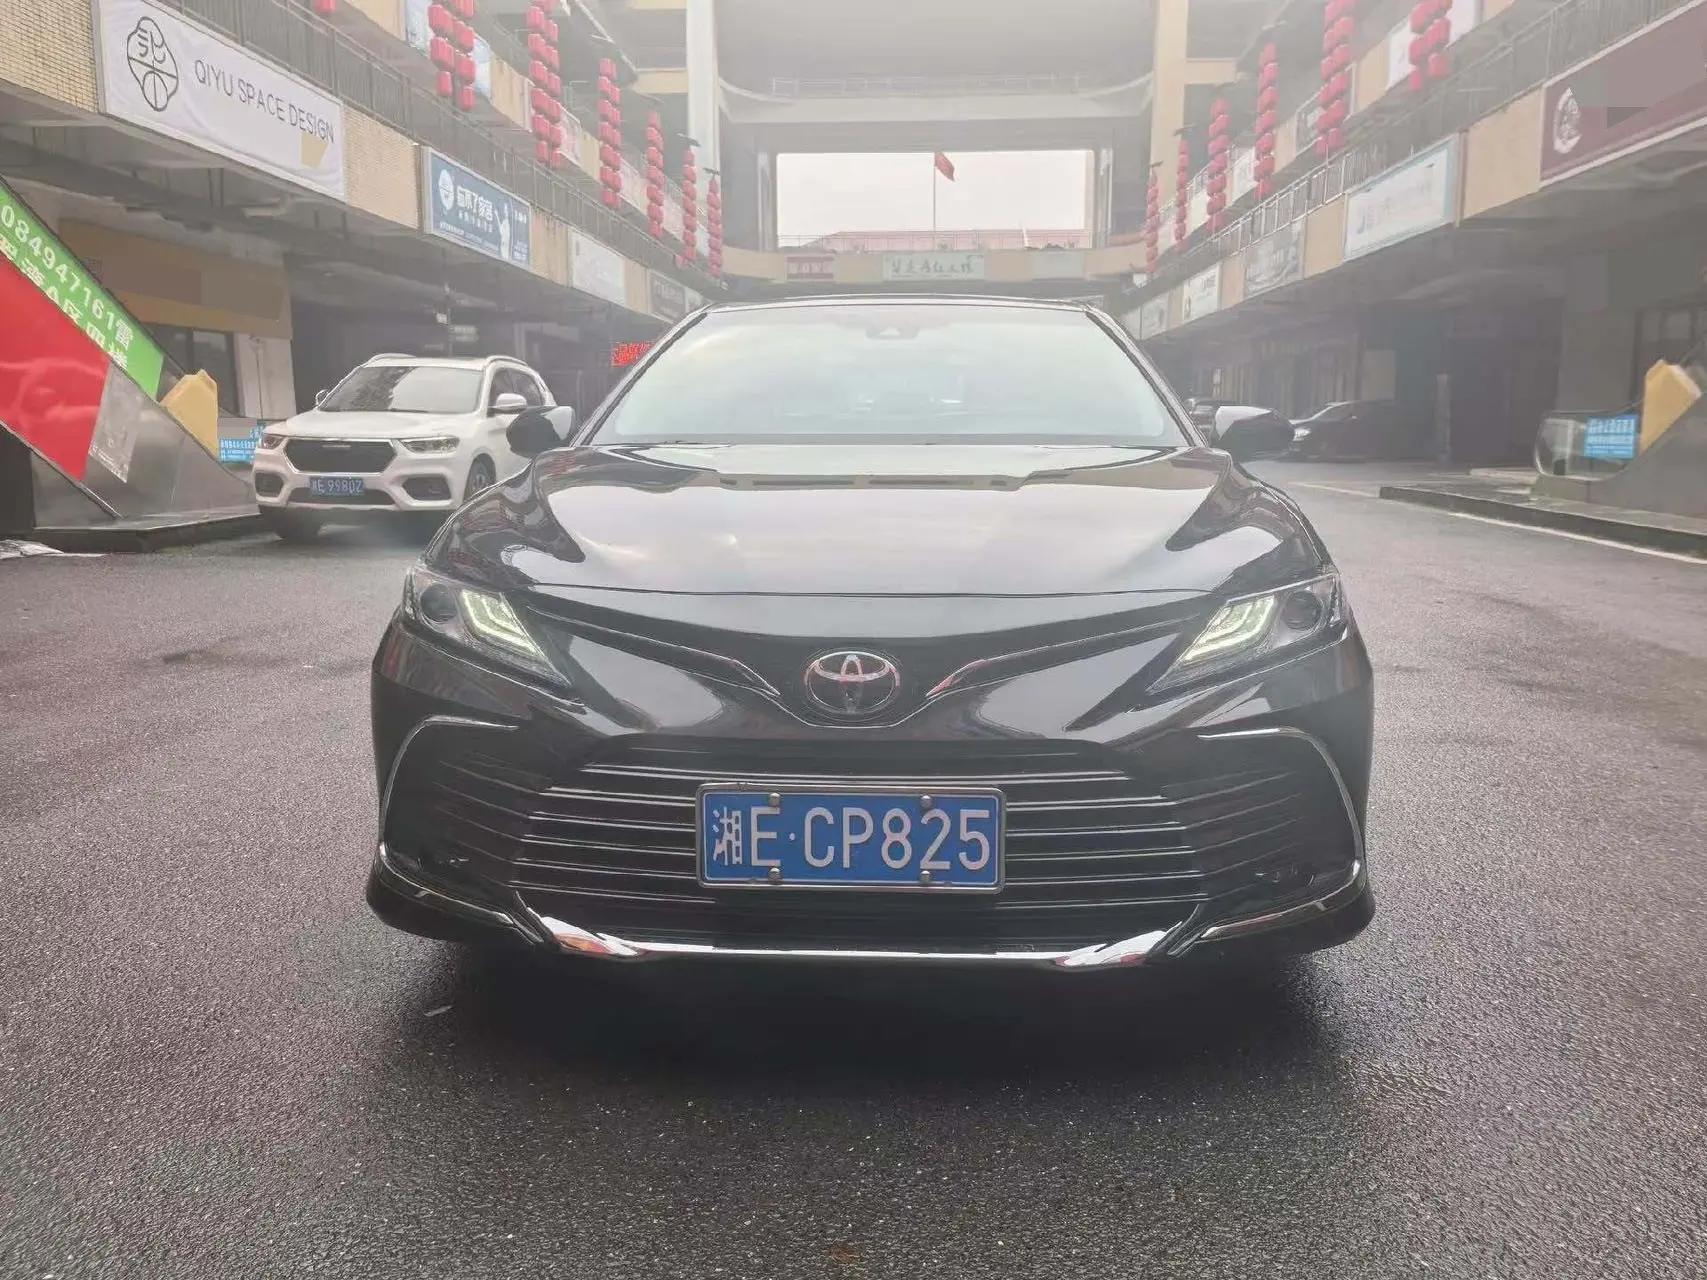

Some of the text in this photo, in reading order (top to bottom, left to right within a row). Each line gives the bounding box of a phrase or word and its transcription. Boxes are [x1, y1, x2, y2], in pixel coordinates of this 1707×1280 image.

[194, 59, 335, 144] QIYU SPACE DESIGN
[712, 805, 991, 871] 湘E·CP825
